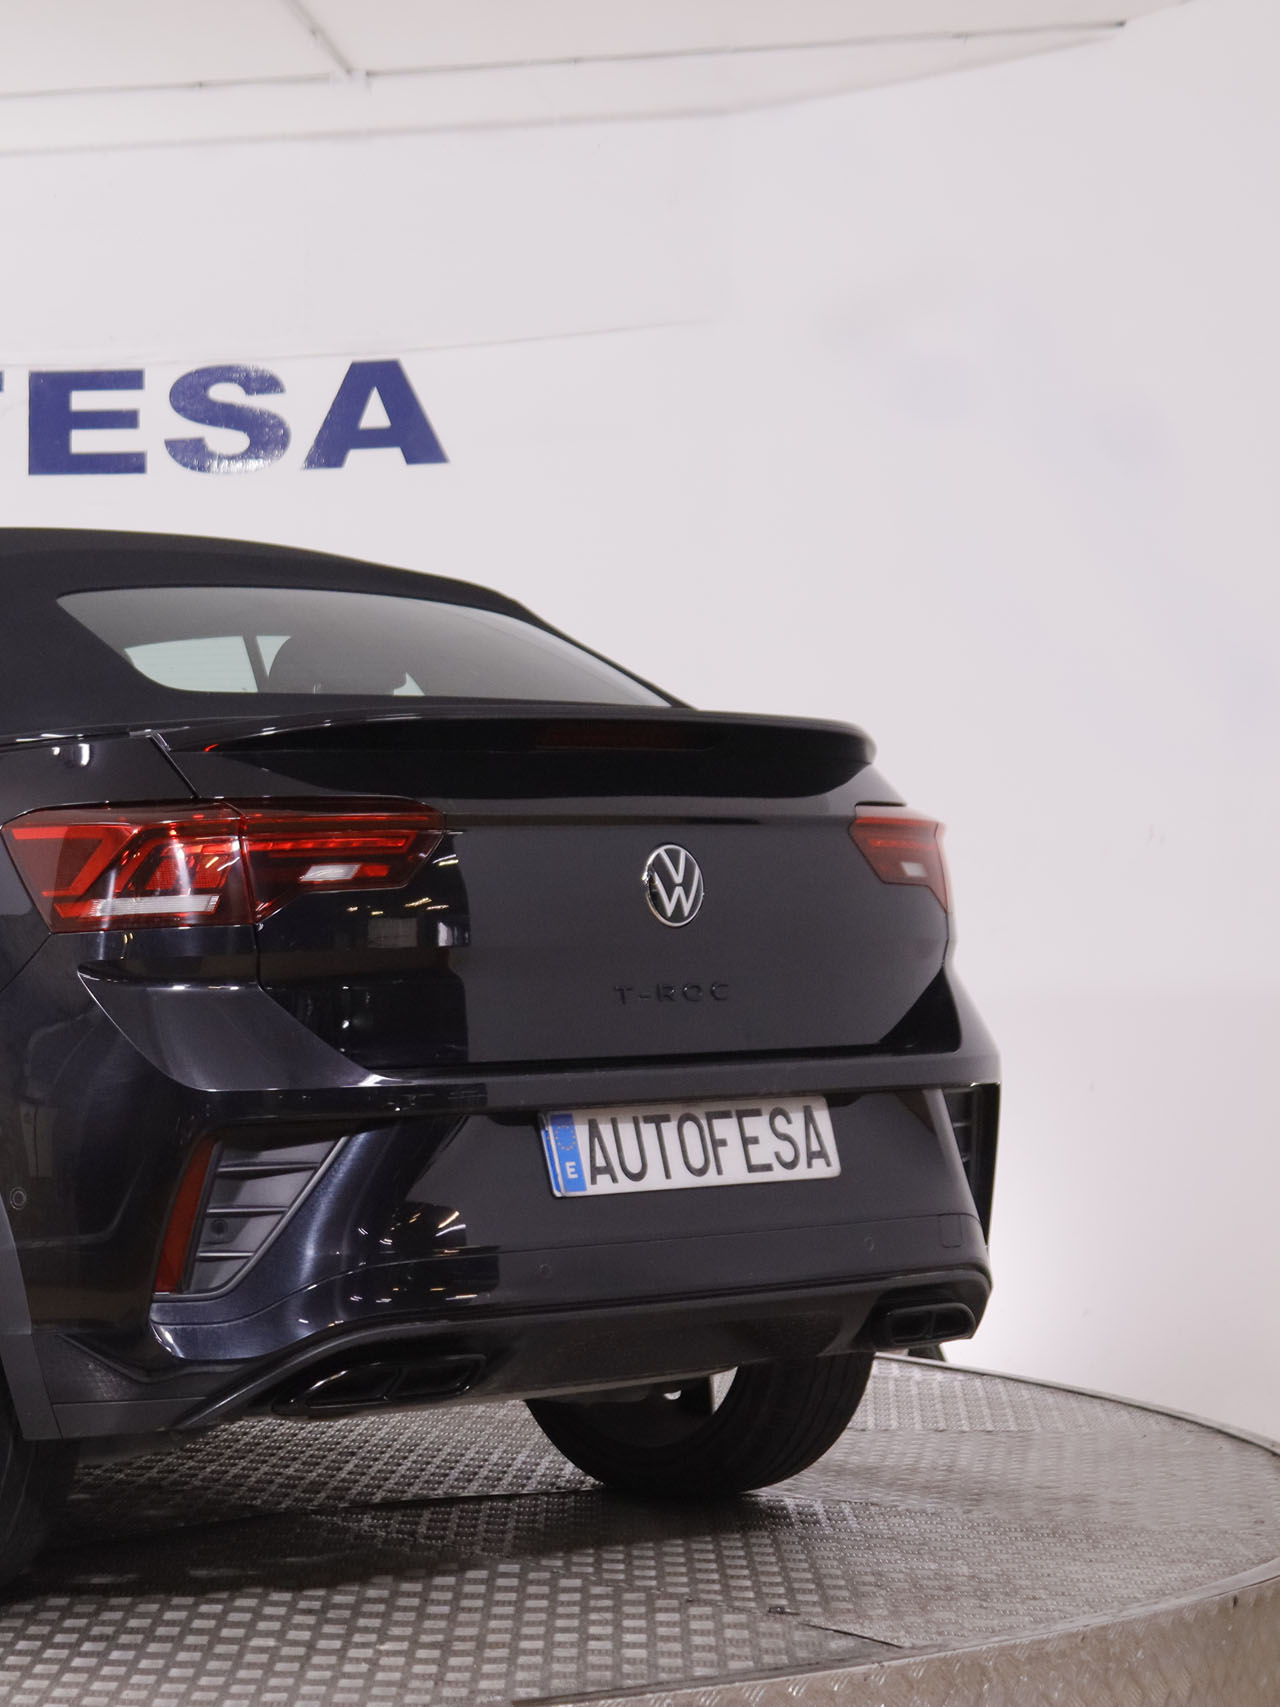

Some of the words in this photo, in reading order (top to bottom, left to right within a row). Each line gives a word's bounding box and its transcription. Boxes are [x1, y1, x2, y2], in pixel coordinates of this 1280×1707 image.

[645, 845, 704, 925] VW
[614, 982, 729, 1004] T-ROC
[565, 1161, 577, 1179] E
[588, 1105, 832, 1185] AUTOFESA
